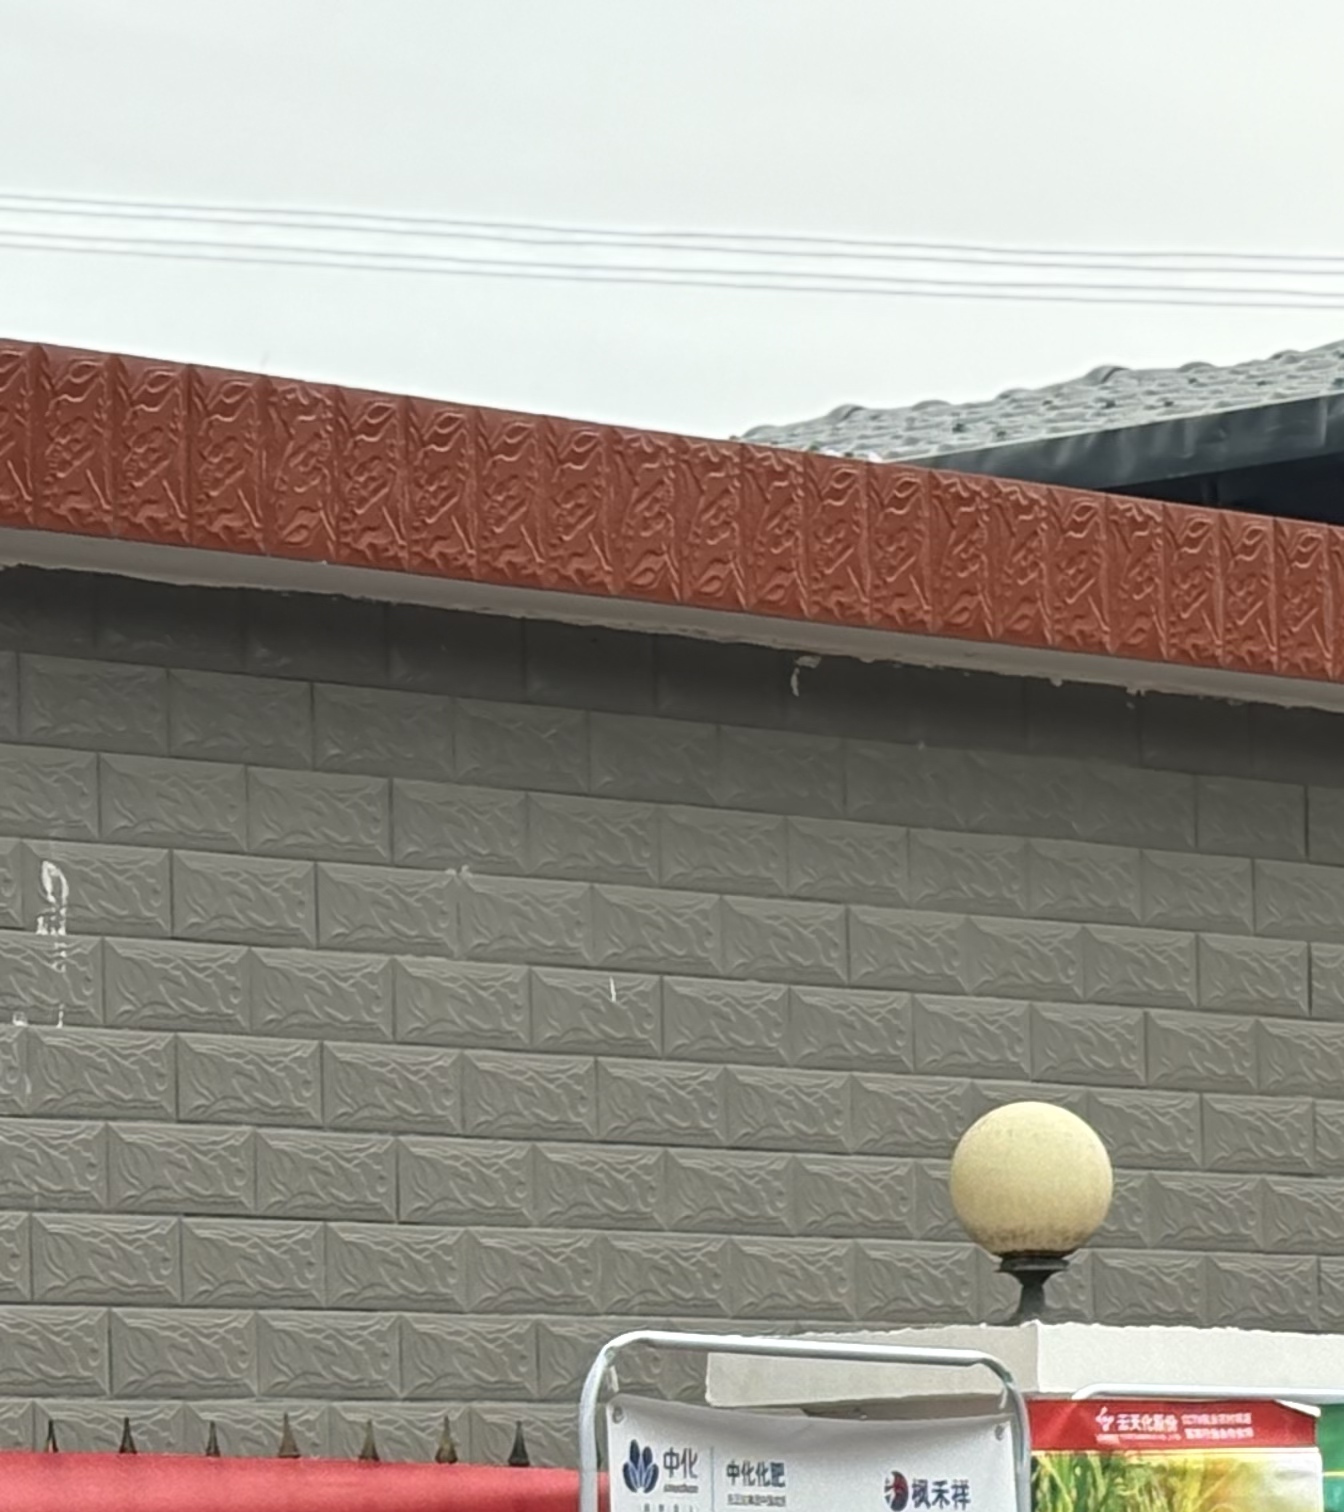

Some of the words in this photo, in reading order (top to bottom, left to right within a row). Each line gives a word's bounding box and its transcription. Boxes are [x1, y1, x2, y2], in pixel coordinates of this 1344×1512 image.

[663, 1448, 698, 1479] 中化
[726, 1460, 786, 1488] 中化化肥
